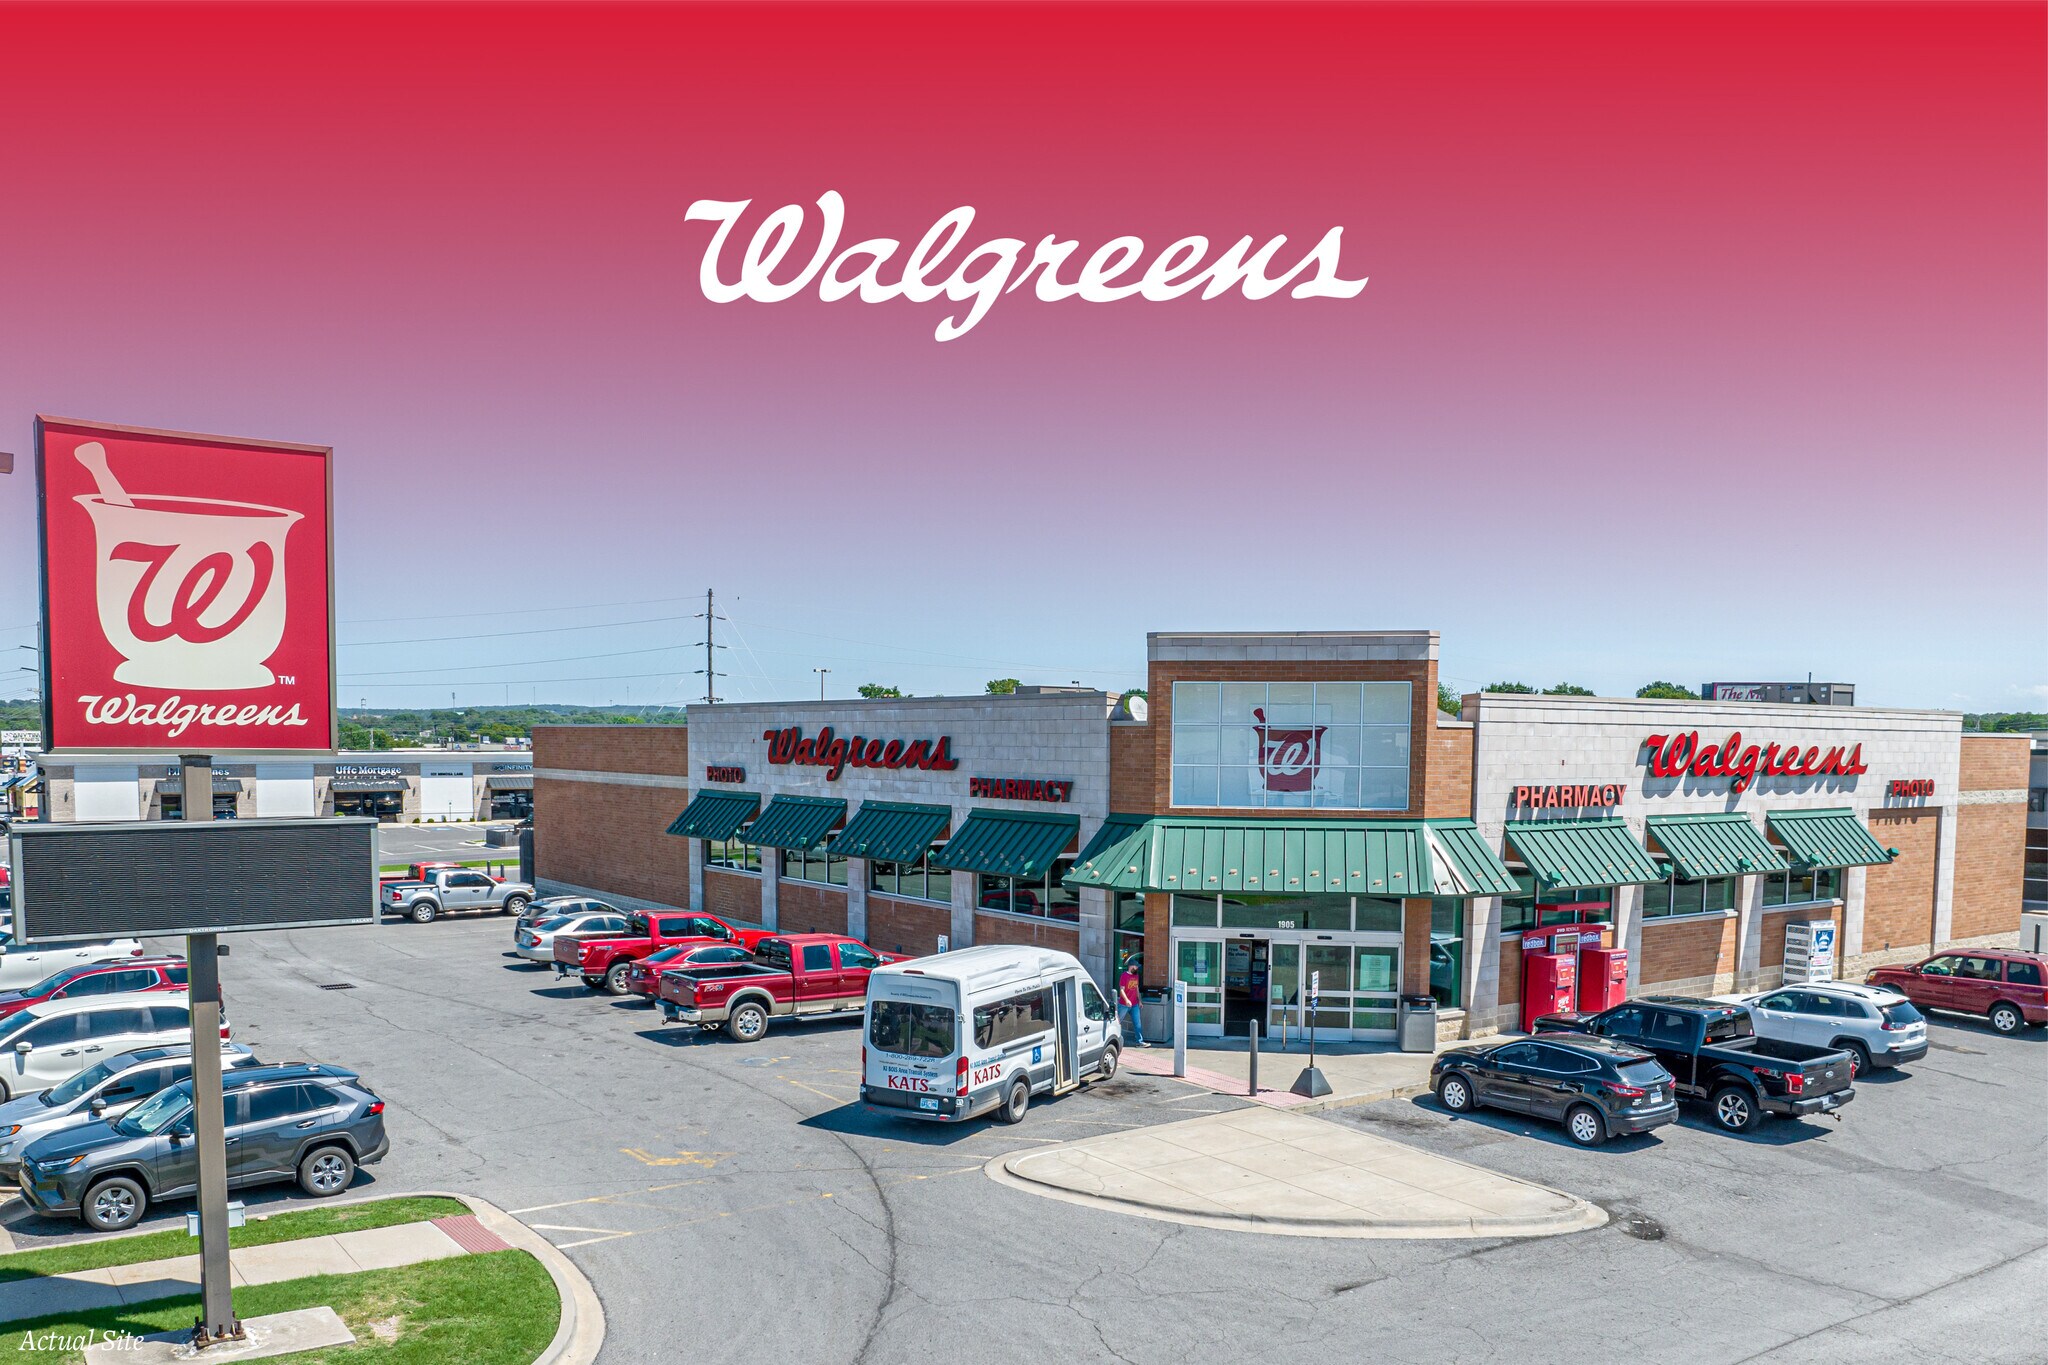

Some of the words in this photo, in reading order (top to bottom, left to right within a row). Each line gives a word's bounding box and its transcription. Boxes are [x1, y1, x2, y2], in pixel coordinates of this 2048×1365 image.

[278, 676, 295, 685] TM
[1721, 688, 1742, 700] The
[77, 693, 308, 737] Walgreens
[763, 726, 958, 781] Walgreens
[1645, 730, 1868, 794] Walgreens
[358, 765, 402, 776] Mortgage
[706, 766, 745, 783] PHOTO
[969, 777, 1074, 803] PHARMACY
[1517, 784, 1628, 808] PHARMACY
[1892, 779, 1935, 797] PHOTO
[1277, 920, 1295, 929] 1905
[1524, 940, 1544, 948] redbox
[1581, 933, 1599, 942] redbox
[908, 1068, 923, 1076] Transit
[923, 1070, 938, 1078] System
[974, 1064, 1001, 1085] KATS
[888, 1075, 929, 1092] KATS
